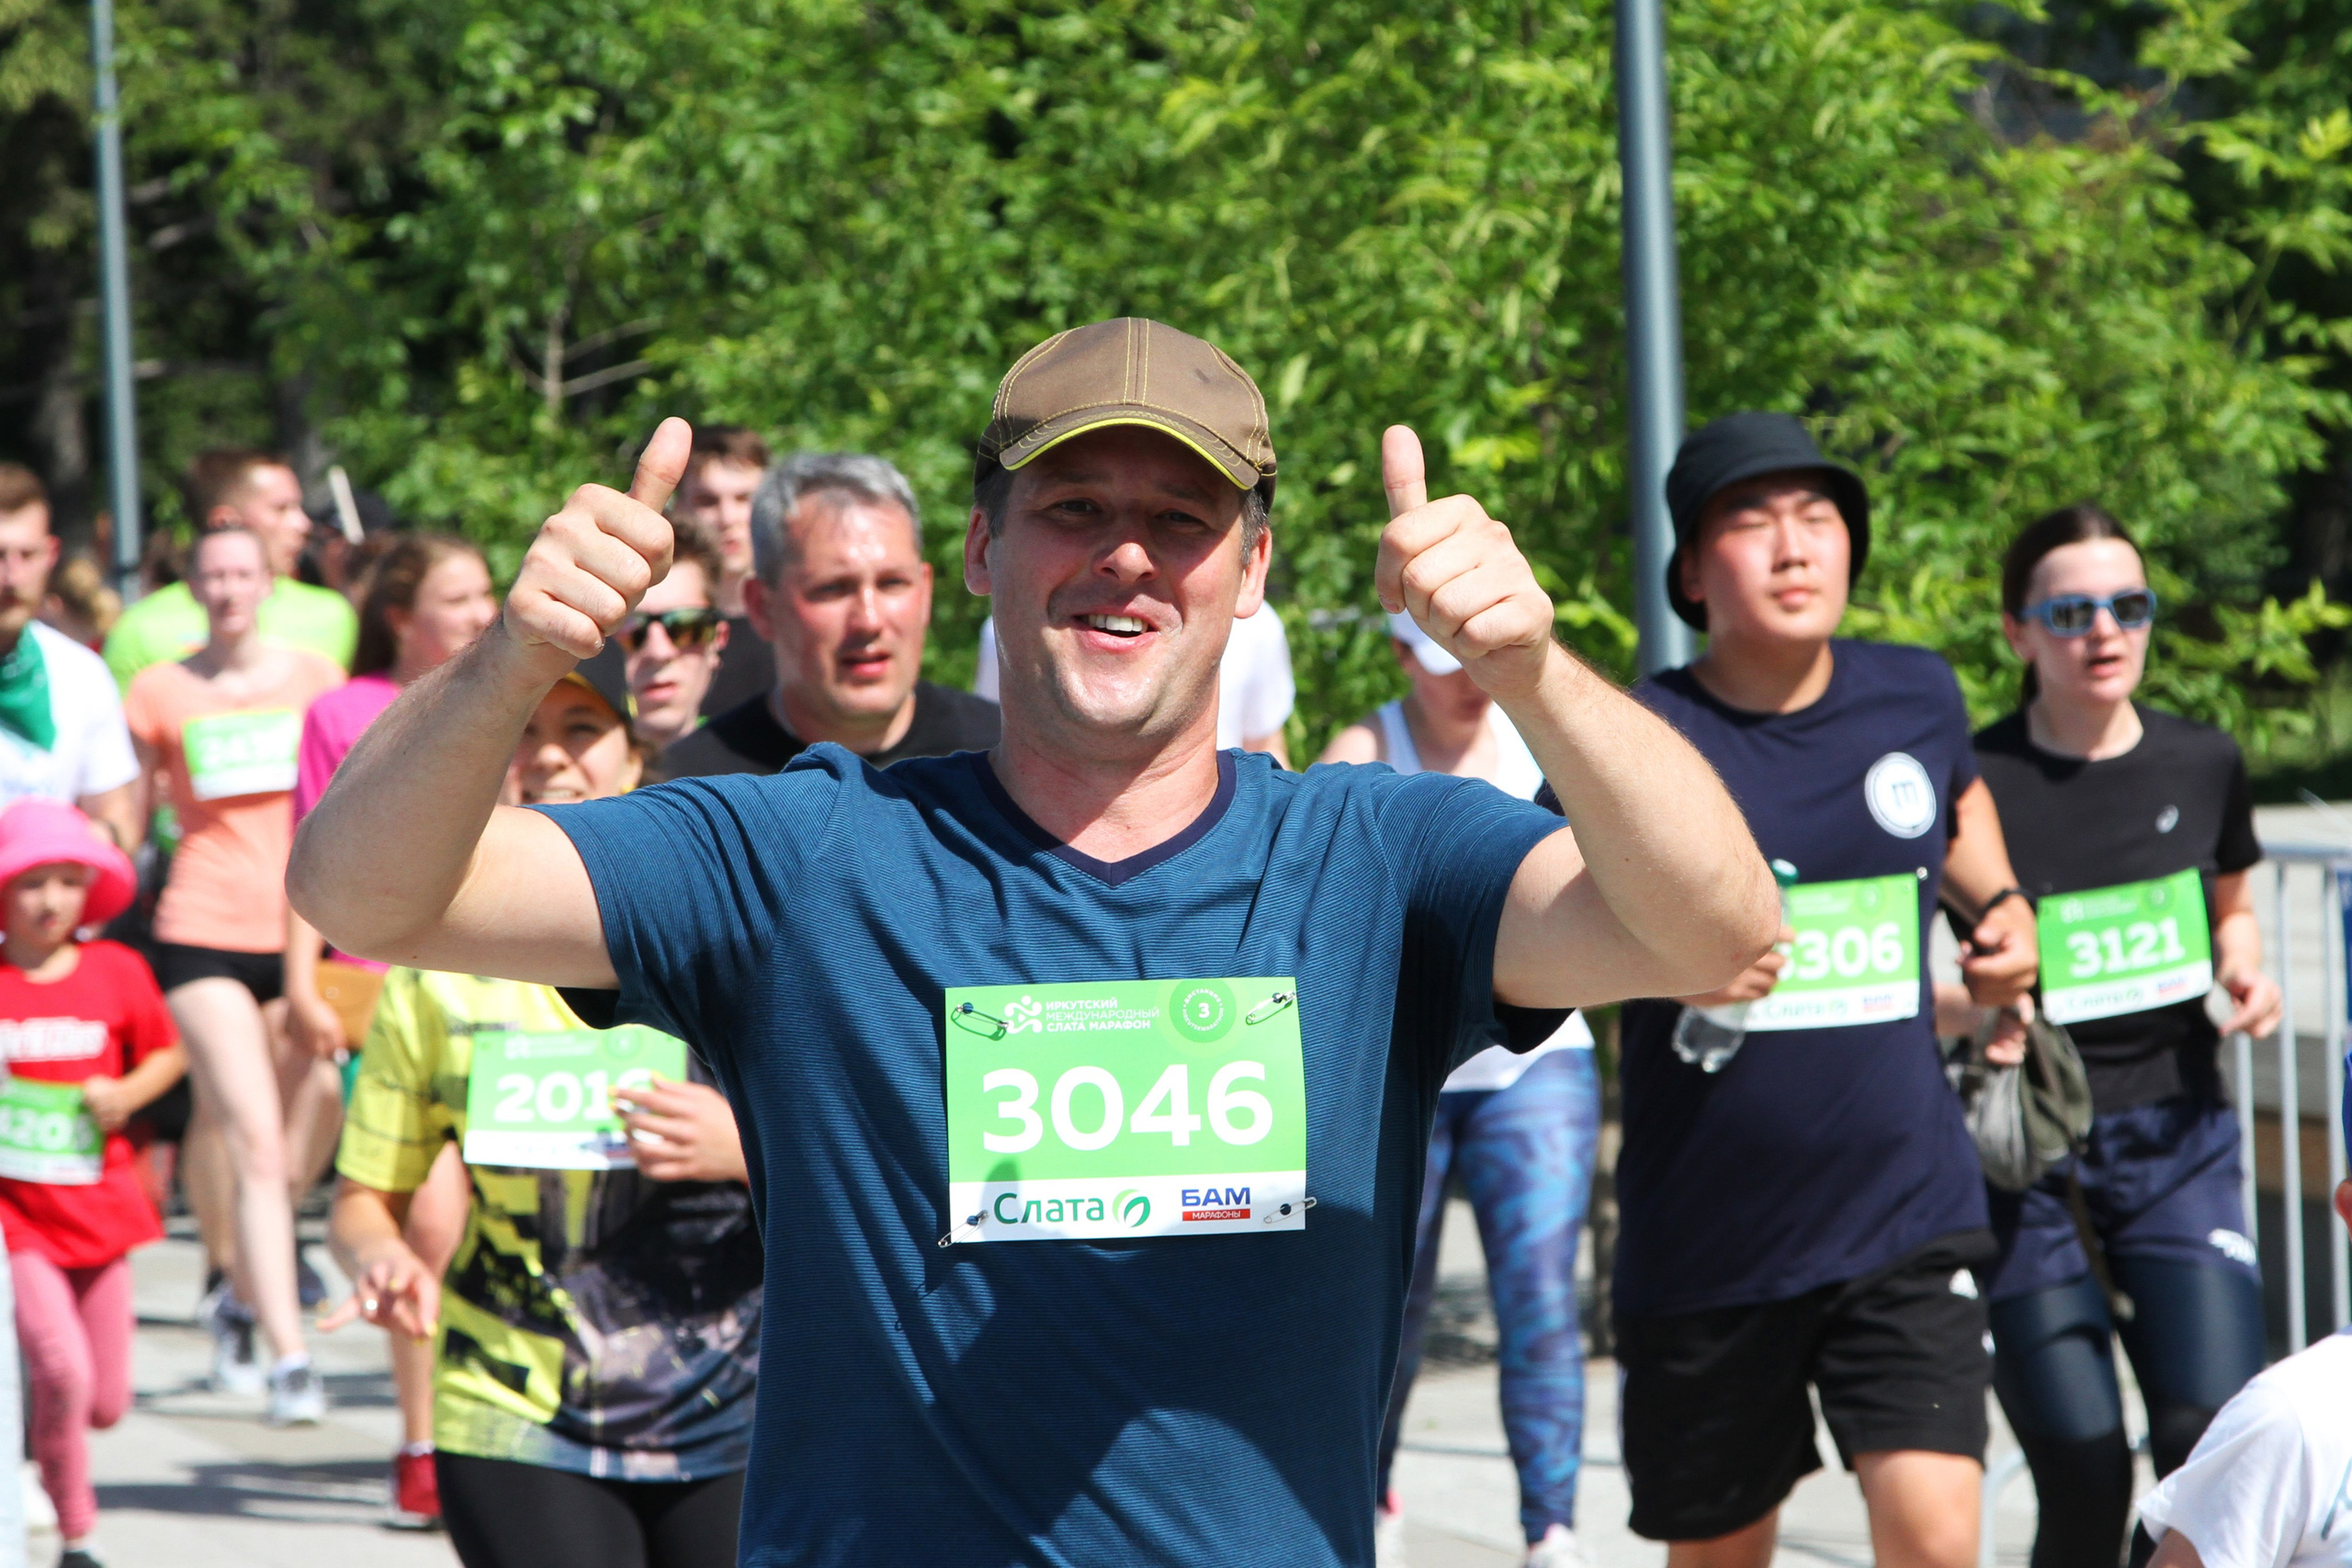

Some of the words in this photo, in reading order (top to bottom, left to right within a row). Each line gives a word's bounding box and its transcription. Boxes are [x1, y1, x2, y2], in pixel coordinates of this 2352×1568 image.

[2066, 916, 2187, 978] 3121
[1046, 996, 1118, 1010] ИРКУТСКИЙ
[1198, 1001, 1211, 1019] 3
[1046, 1007, 1160, 1021] МЕЖДУНАРОДНЫЙ
[1046, 1021, 1086, 1032] СЛАТА
[1089, 1020, 1151, 1032] МАРАФОН
[982, 1060, 1274, 1154] 3046
[1182, 1187, 1251, 1207] БАМ
[994, 1192, 1104, 1224] Слата
[1192, 1210, 1241, 1220] МАРАФОНЫ
